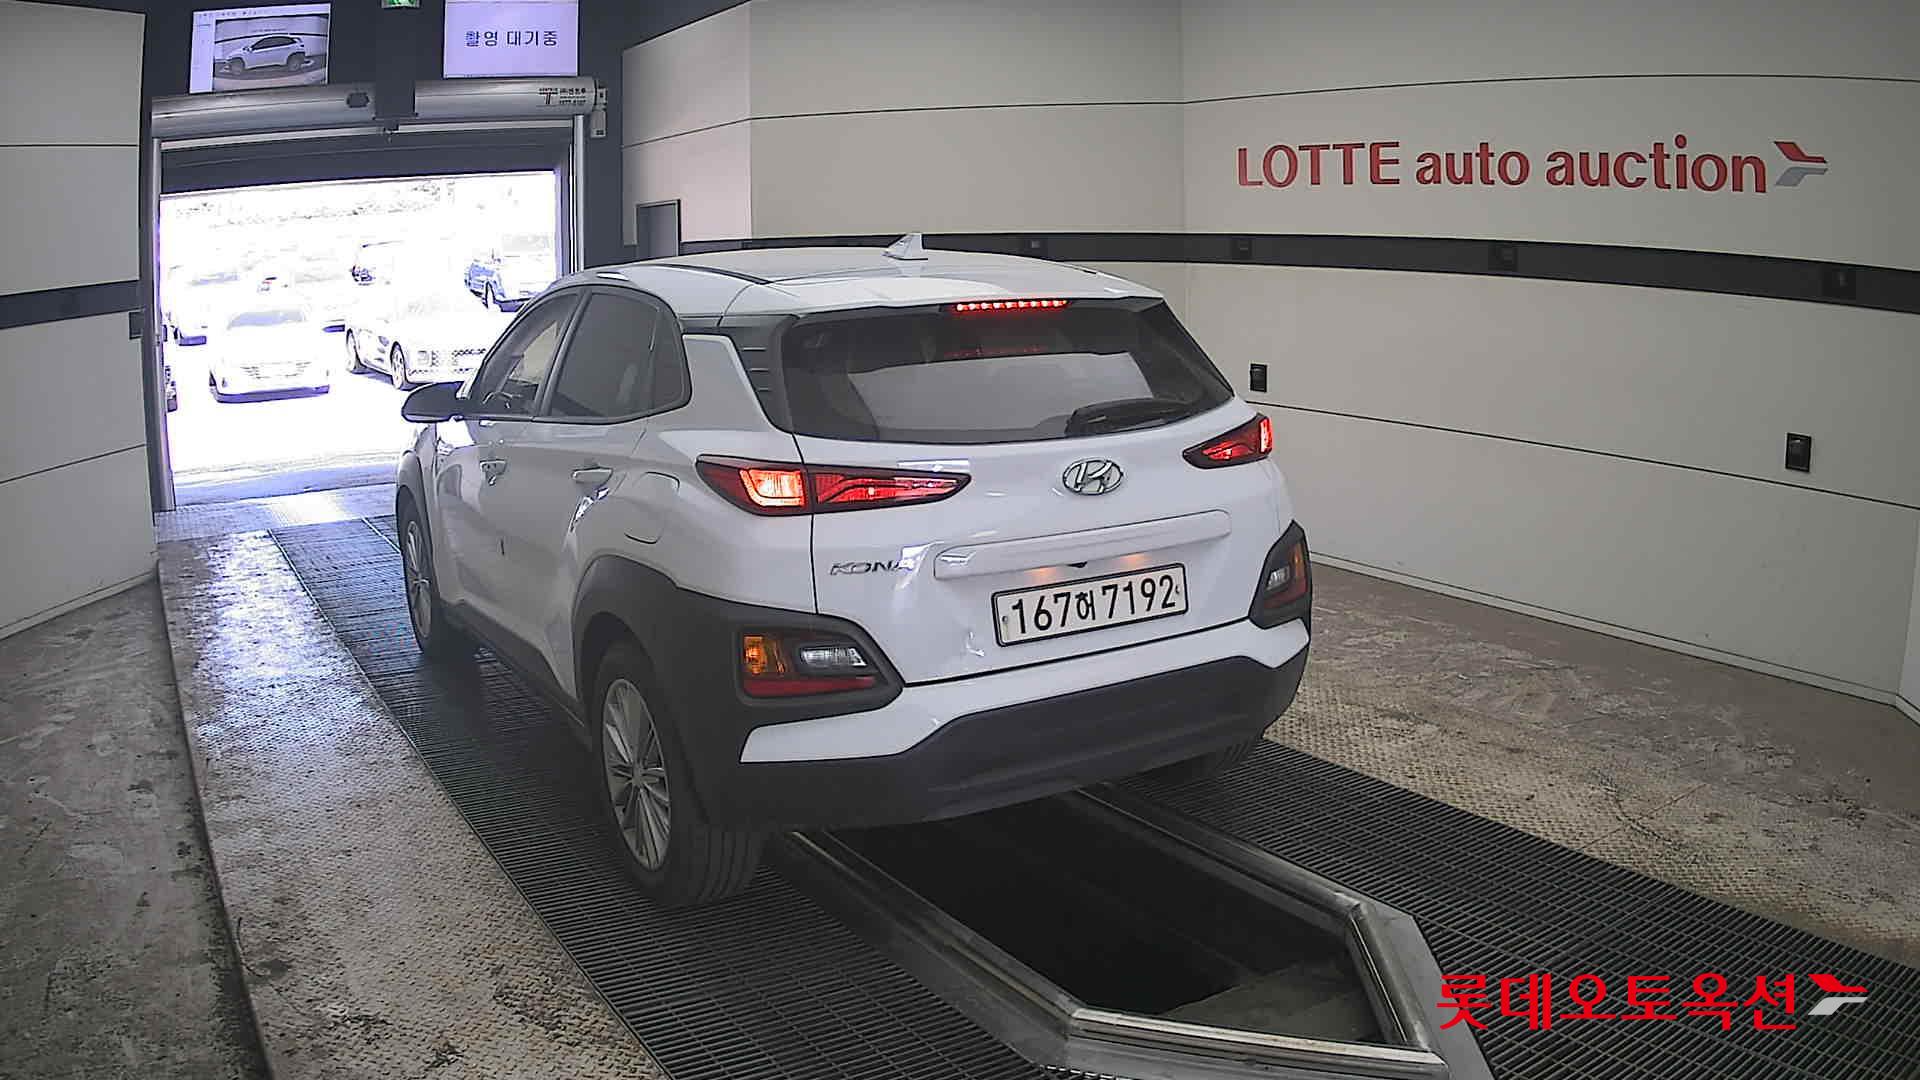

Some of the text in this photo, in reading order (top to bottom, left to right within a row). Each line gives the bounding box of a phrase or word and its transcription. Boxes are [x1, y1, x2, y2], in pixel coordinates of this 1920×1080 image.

[1237, 134, 1767, 193] LOTTE auto auction
